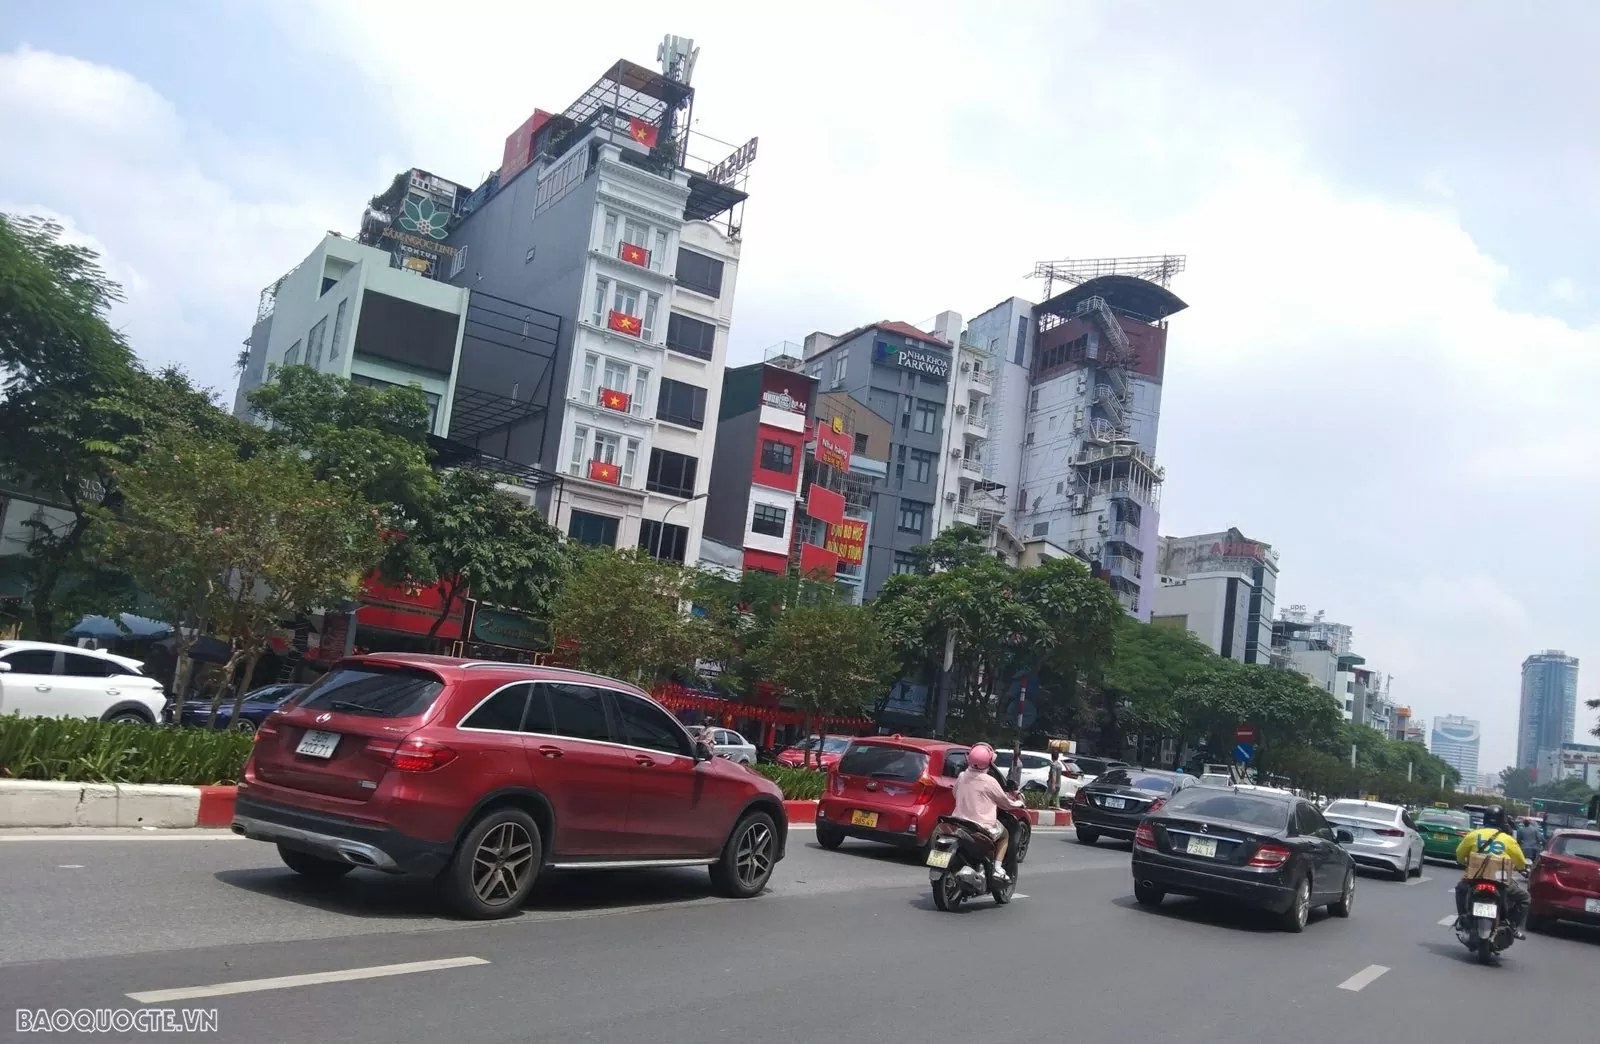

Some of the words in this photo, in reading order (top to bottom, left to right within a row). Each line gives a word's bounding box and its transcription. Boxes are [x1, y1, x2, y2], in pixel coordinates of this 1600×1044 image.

[897, 351, 948, 377] PARKWAY
[907, 350, 925, 362] NHA
[926, 355, 948, 368] KHOA
